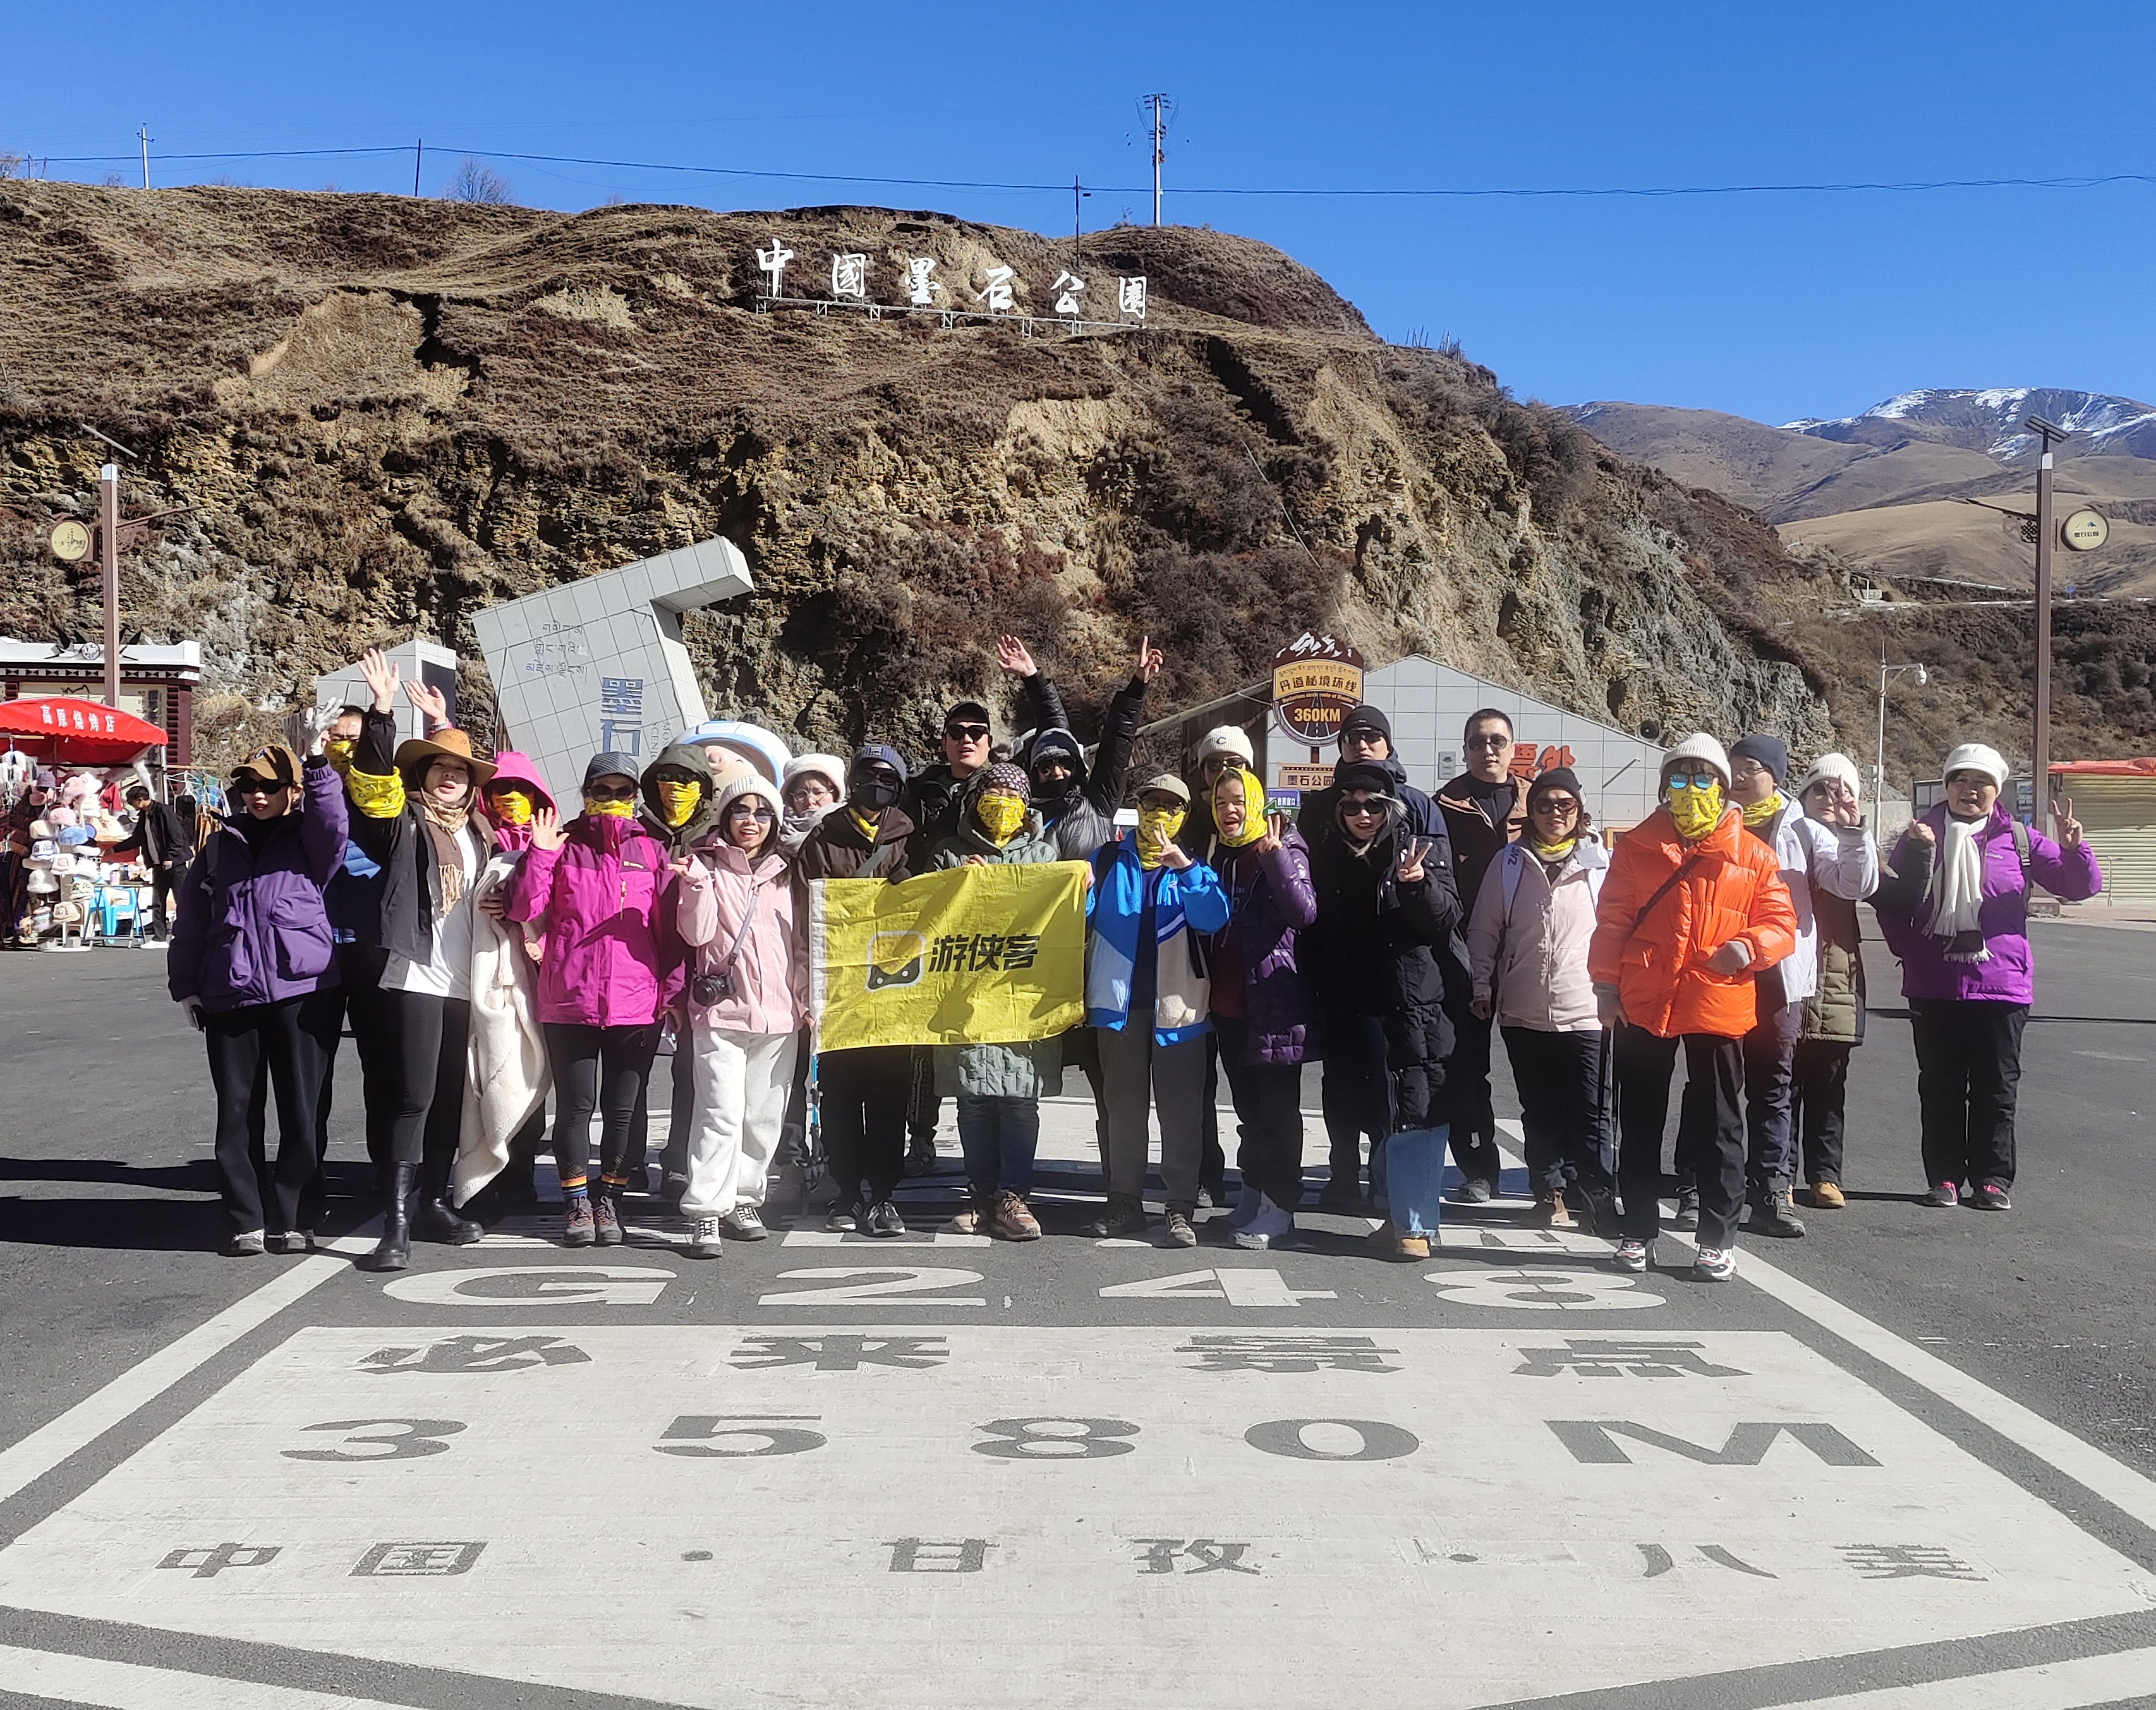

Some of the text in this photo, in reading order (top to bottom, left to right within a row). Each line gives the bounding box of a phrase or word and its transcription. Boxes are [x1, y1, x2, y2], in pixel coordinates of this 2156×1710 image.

[1280, 675, 1357, 692] 丹道秘境环线
[40, 705, 115, 732] 高原烧烤店
[600, 677, 643, 756] 墨石
[1294, 708, 1341, 722] 360KM
[1287, 775, 1333, 786] 墨石公园
[929, 933, 1041, 972] 游侠客
[382, 1265, 1667, 1310] G248
[282, 1415, 1884, 1467] 3580M
